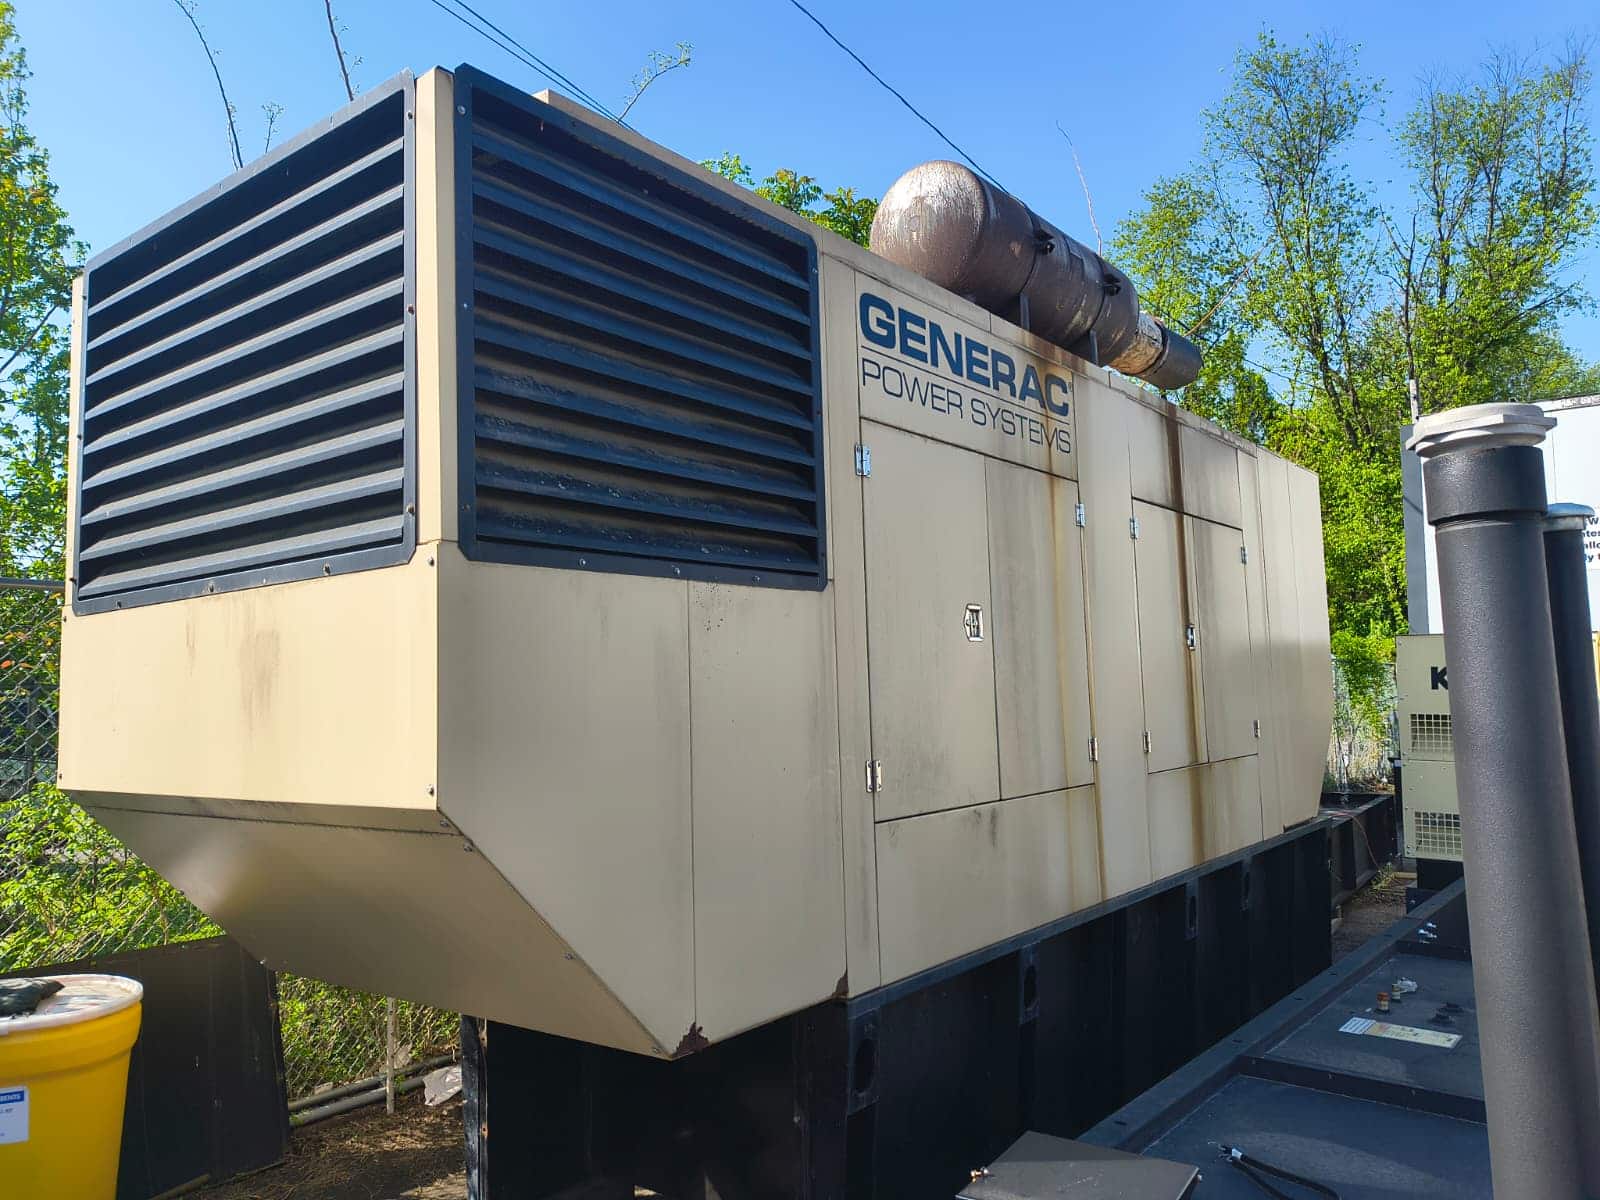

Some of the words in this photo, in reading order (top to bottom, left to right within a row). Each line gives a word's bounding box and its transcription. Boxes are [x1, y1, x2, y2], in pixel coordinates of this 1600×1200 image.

[859, 292, 1069, 417] GENERAC
[862, 358, 963, 419] POWER
[971, 398, 1071, 454] SYSTEMS
